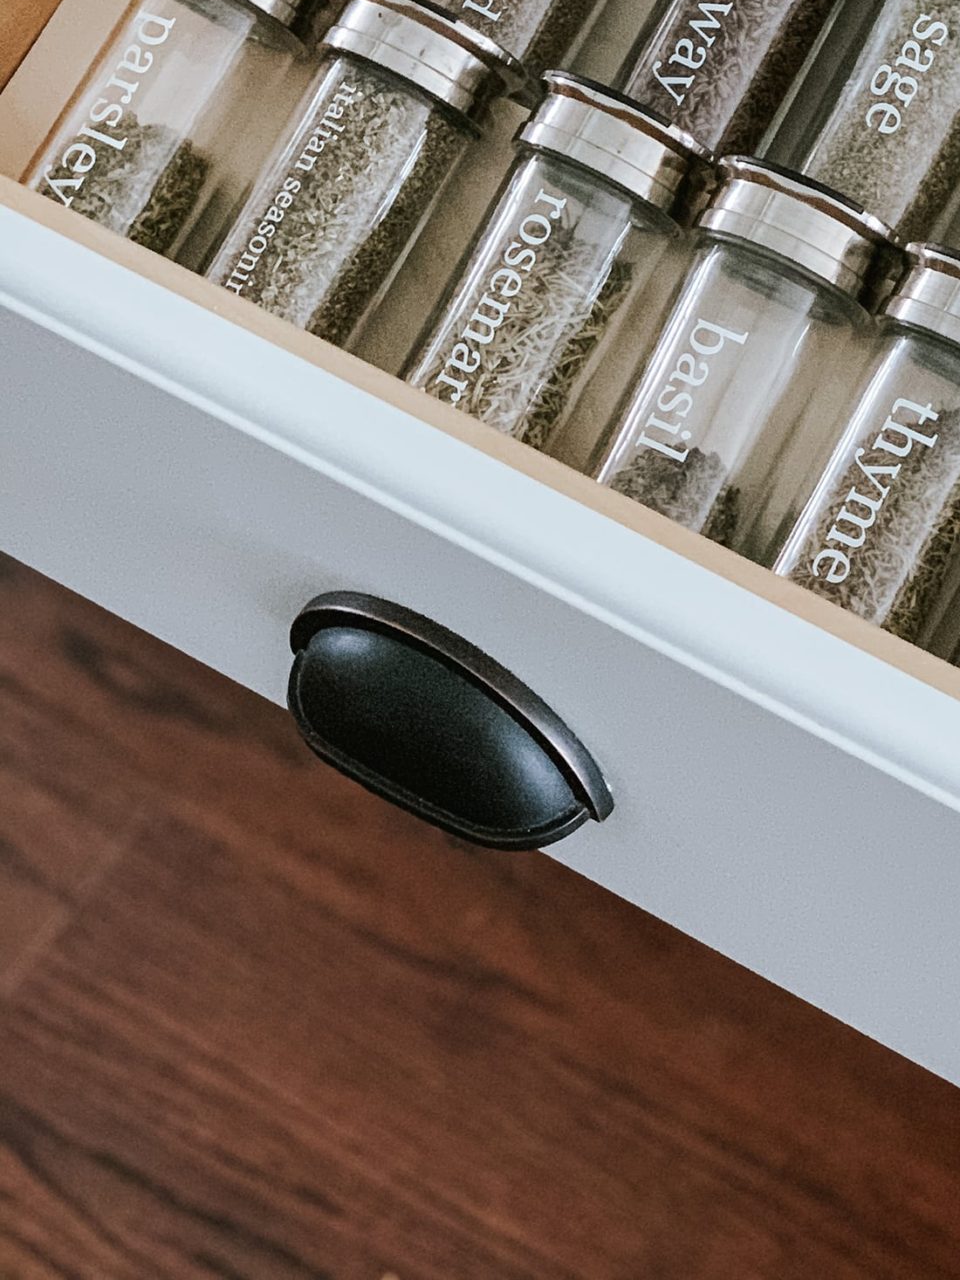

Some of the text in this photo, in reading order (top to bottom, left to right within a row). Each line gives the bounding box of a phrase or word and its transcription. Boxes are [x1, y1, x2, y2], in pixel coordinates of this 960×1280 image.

[43, 9, 177, 209] parsley
[294, 81, 364, 172] italian
[865, 13, 949, 135] sage
[435, 188, 568, 404] rosemar
[635, 318, 750, 463] basil
[812, 397, 941, 585] thyme
